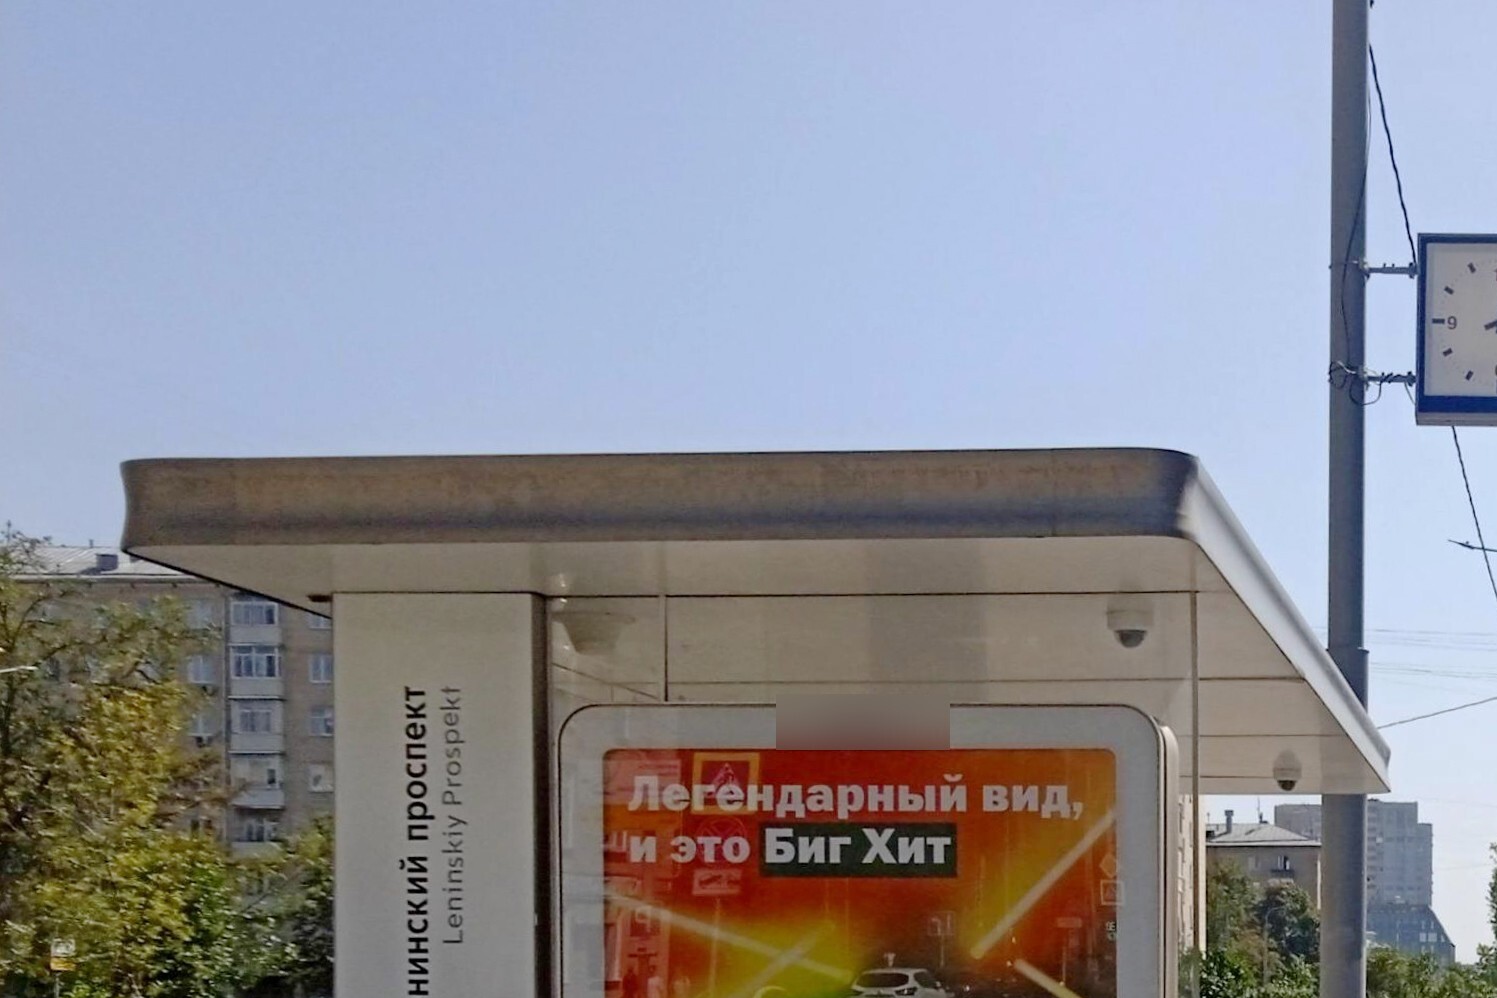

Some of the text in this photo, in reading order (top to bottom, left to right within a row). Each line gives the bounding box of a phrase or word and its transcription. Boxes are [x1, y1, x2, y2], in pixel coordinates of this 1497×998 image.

[1447, 316, 1457, 330] 9
[404, 686, 436, 842] проспект
[440, 685, 469, 945] Leninskiy Prospekt
[627, 773, 1084, 821] Легендарный вид,
[629, 827, 952, 865] и это Биг Хит
